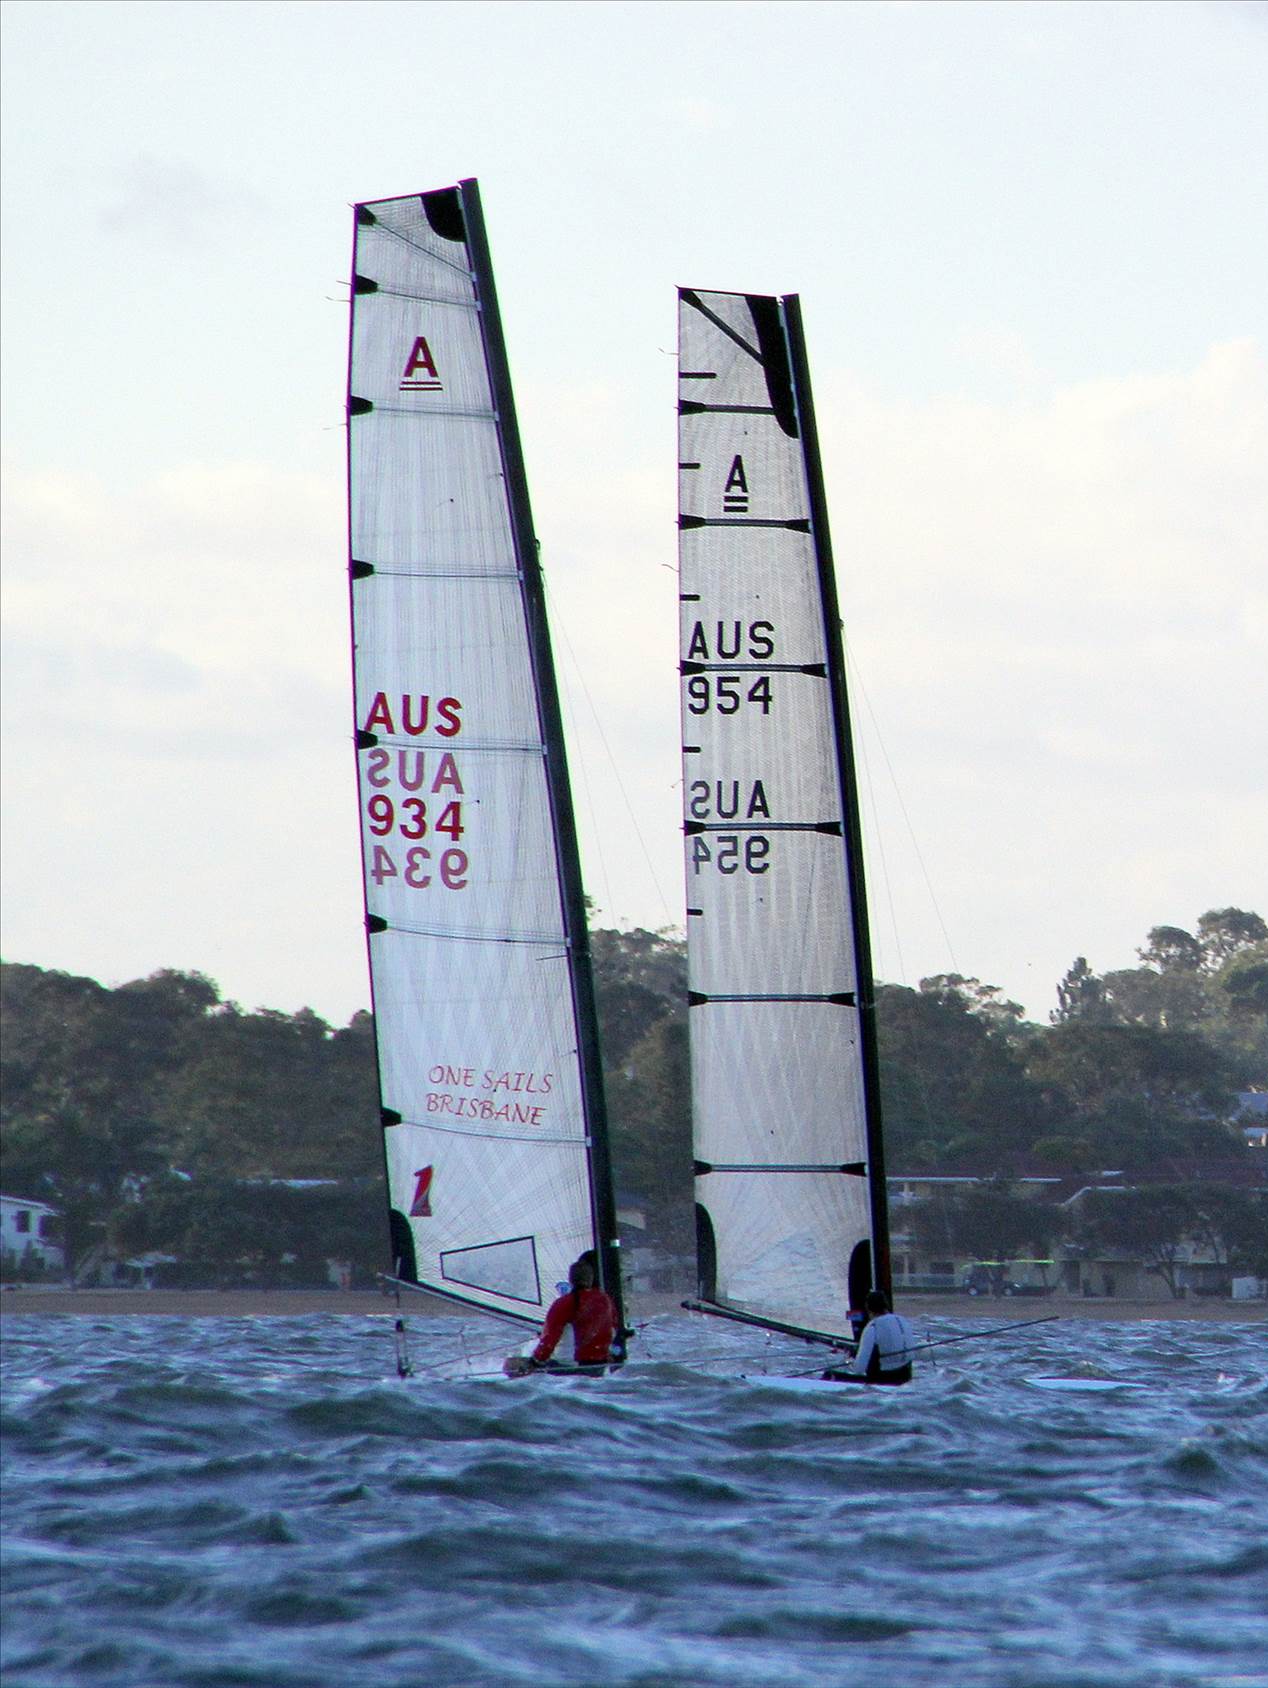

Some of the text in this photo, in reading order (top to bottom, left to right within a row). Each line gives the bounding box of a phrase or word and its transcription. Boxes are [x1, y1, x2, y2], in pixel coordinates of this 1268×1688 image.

[404, 336, 439, 378] A
[724, 454, 748, 493] A
[688, 621, 774, 660] AUS
[364, 692, 463, 737] AUS
[688, 676, 773, 715] 954
[367, 794, 465, 842] 934
[428, 1065, 553, 1094] ONE SAILS
[425, 1092, 546, 1126] BRISBANE
[409, 1164, 433, 1217] 1
